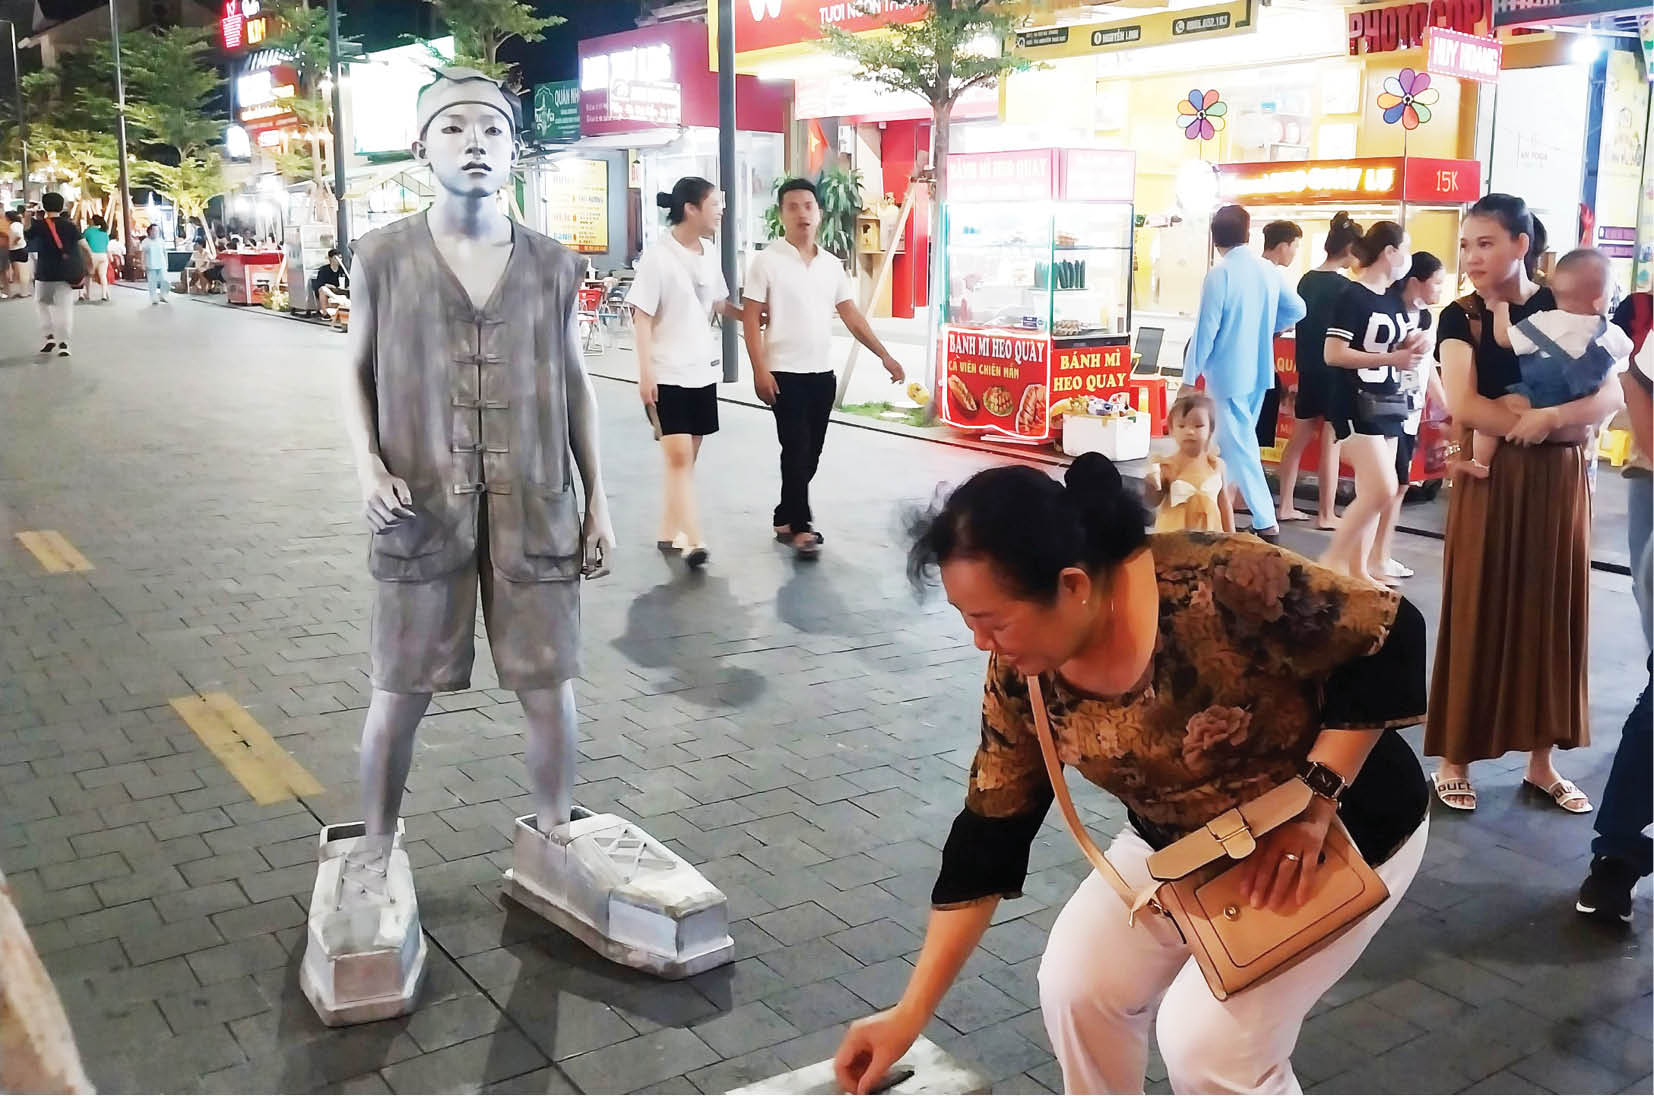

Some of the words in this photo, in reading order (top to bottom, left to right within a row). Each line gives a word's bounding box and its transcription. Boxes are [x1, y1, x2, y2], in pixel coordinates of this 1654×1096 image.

[1436, 169, 1459, 192] 15K
[991, 337, 1012, 360] HEO
[1060, 351, 1101, 369] BÁNH
[1104, 348, 1120, 367] MÌ
[1053, 375, 1083, 392] HEO
[1086, 372, 1127, 392] QUAY
